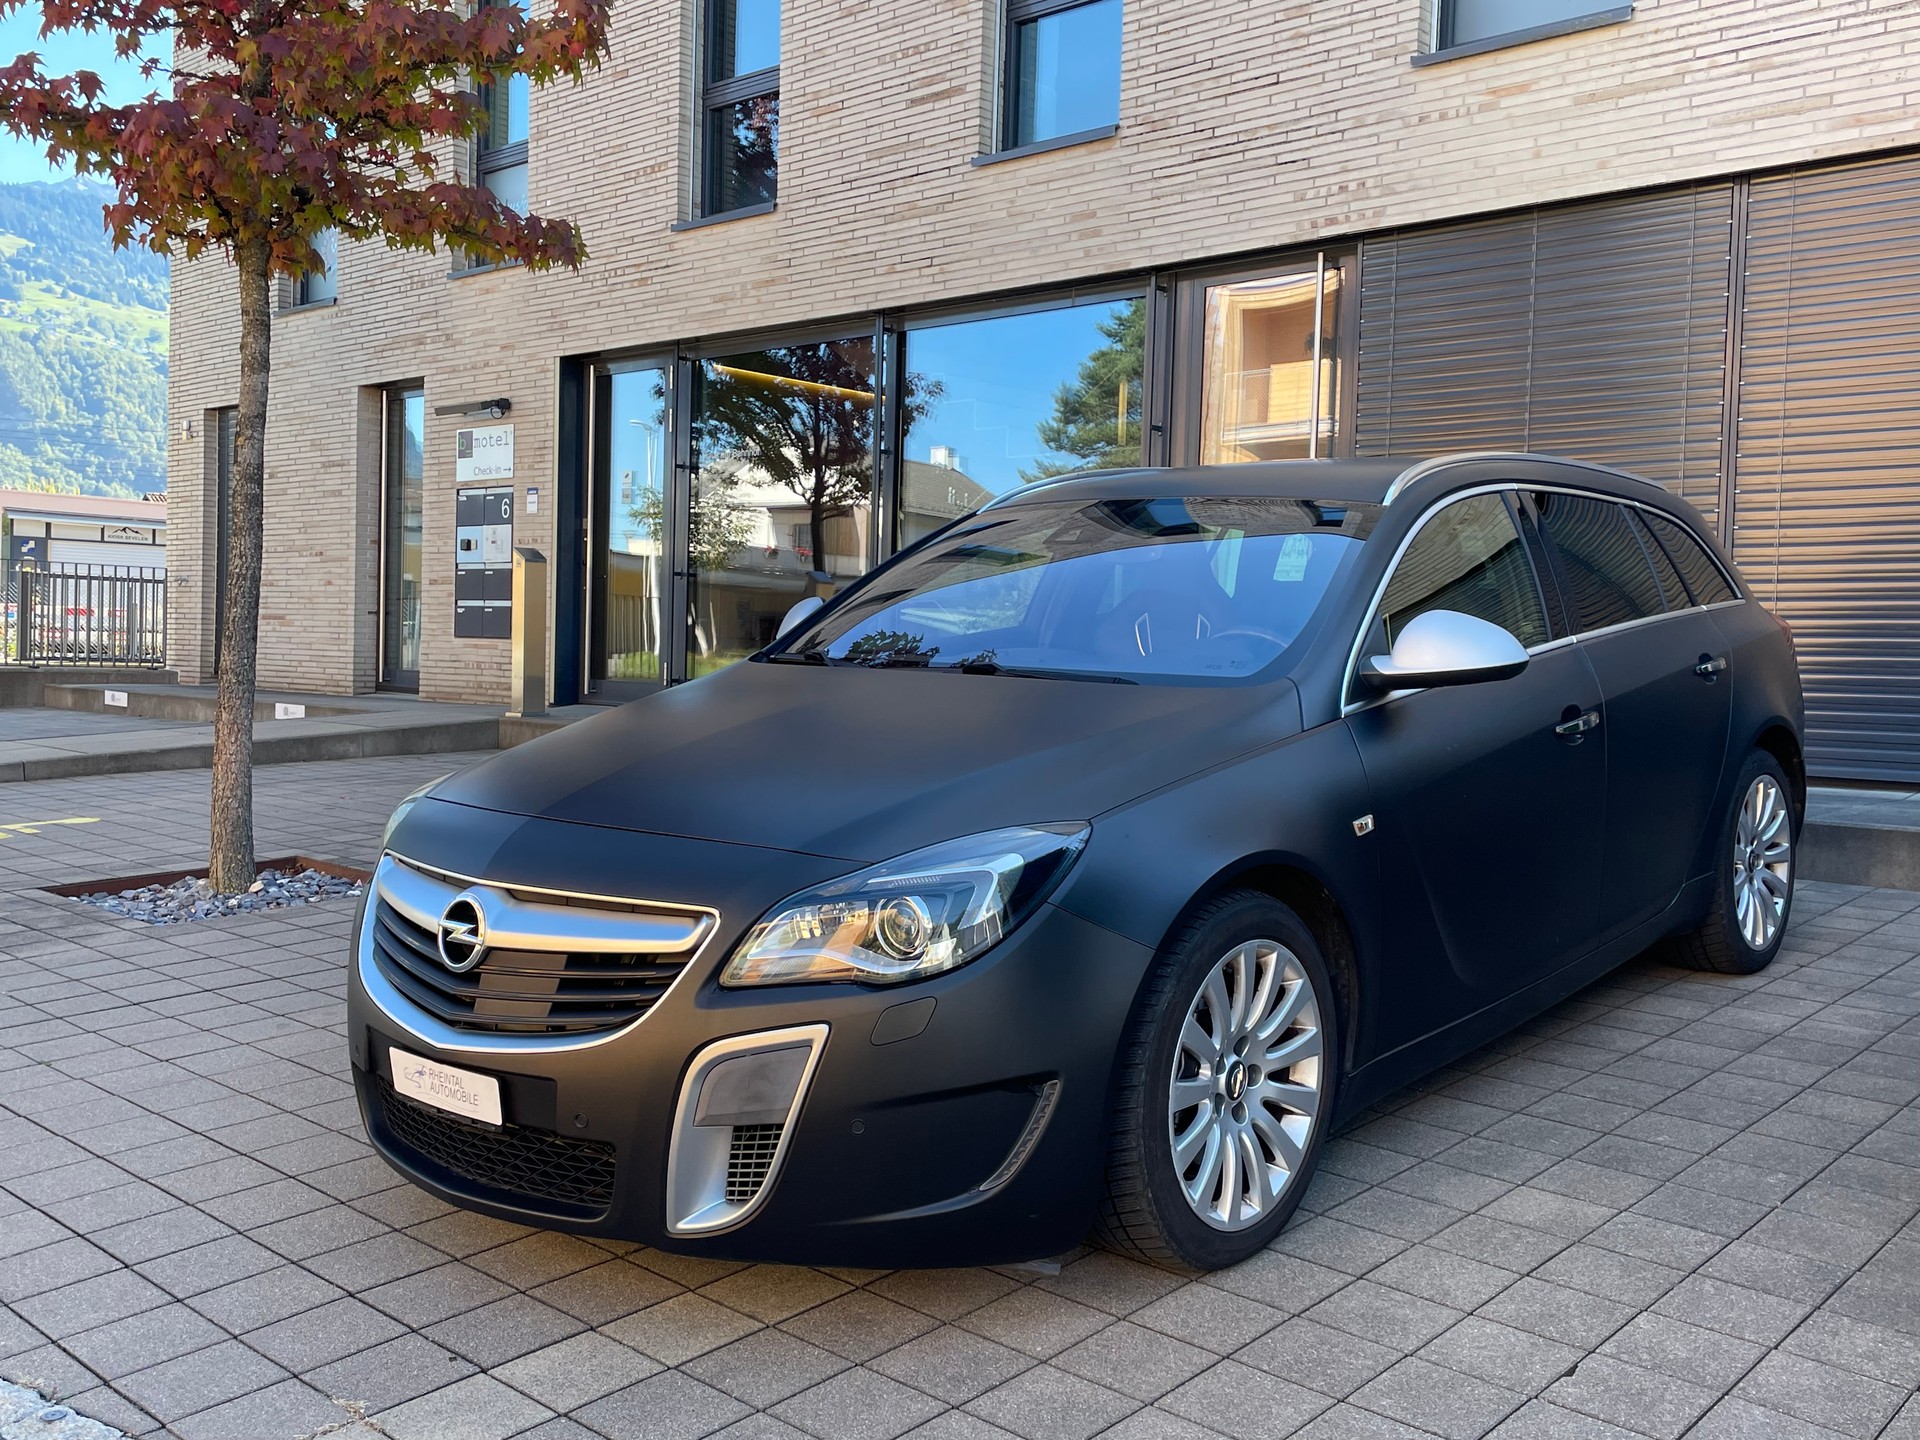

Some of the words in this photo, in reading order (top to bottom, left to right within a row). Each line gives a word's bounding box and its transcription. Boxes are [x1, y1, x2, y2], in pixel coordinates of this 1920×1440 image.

[473, 430, 510, 449] motel
[473, 465, 502, 476] Check-in
[501, 498, 510, 518] 6
[428, 1067, 465, 1090] RHEINTAL
[430, 1081, 479, 1107] AUTOMOBILE
